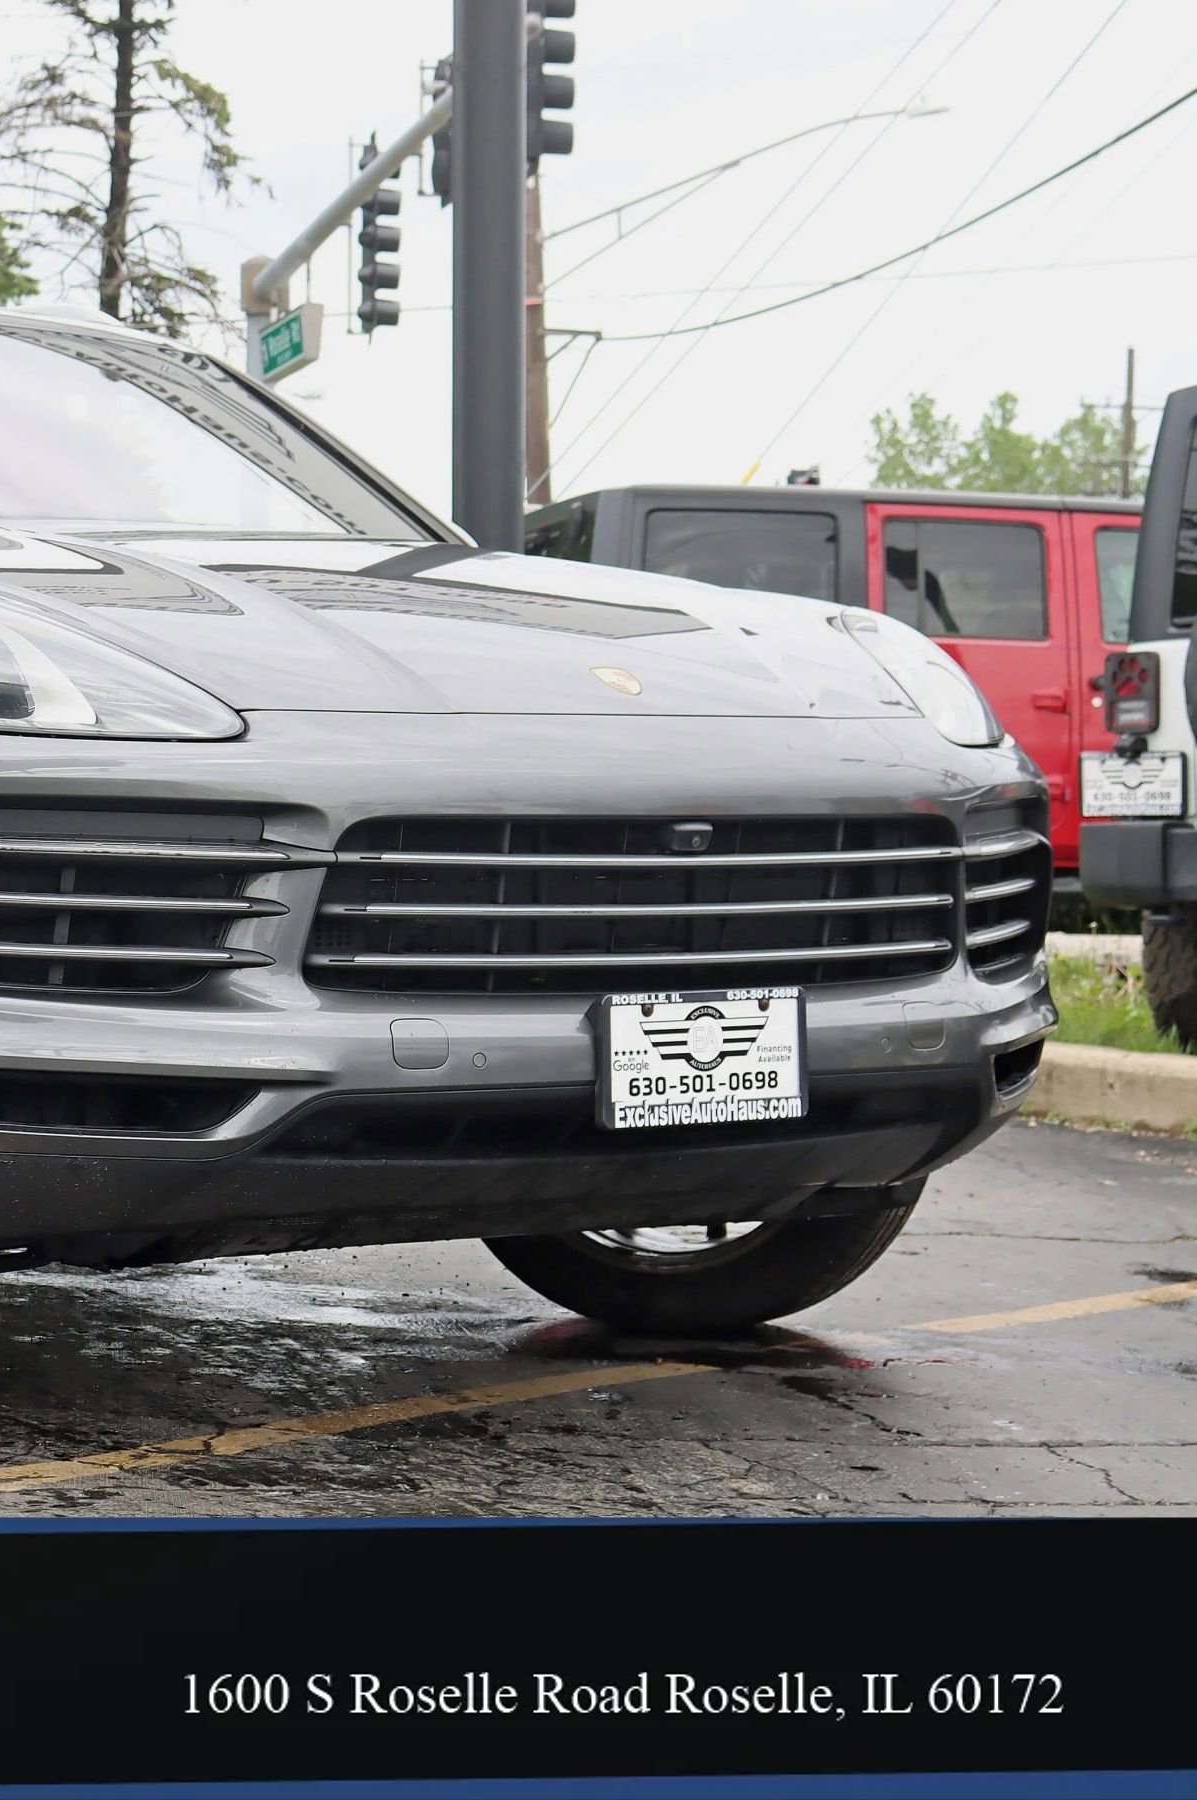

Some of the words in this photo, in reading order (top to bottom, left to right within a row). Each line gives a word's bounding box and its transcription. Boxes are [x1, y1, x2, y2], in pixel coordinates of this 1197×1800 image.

[727, 988, 799, 1000] 630-501-0698
[613, 1059, 650, 1074] Google
[629, 1071, 779, 1096] 630-501-0698
[615, 1095, 802, 1129] ExclusiveAutoHaus.com
